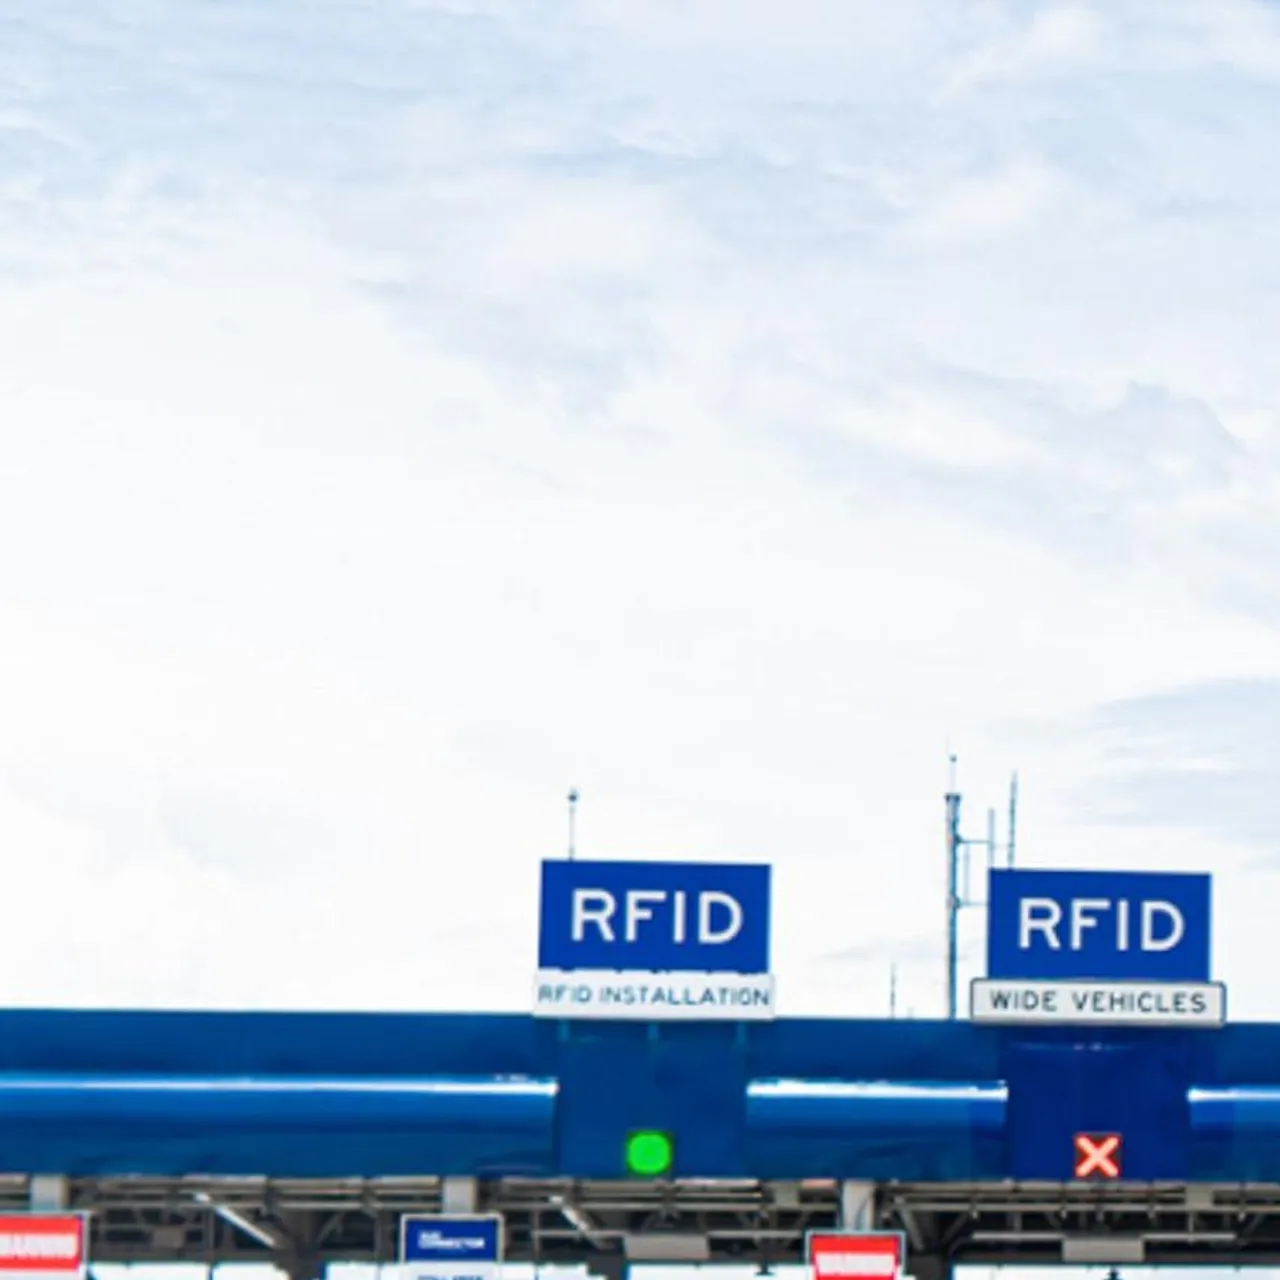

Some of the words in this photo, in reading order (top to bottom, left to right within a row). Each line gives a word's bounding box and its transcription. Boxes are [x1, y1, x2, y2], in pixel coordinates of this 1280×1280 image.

[572, 888, 742, 944] RFID
[1019, 897, 1185, 951] RFID
[538, 983, 592, 1003] RFID
[599, 985, 769, 1006] INSTALLATION
[991, 989, 1057, 1011] WIDE
[1072, 990, 1206, 1013] VEHICLES
